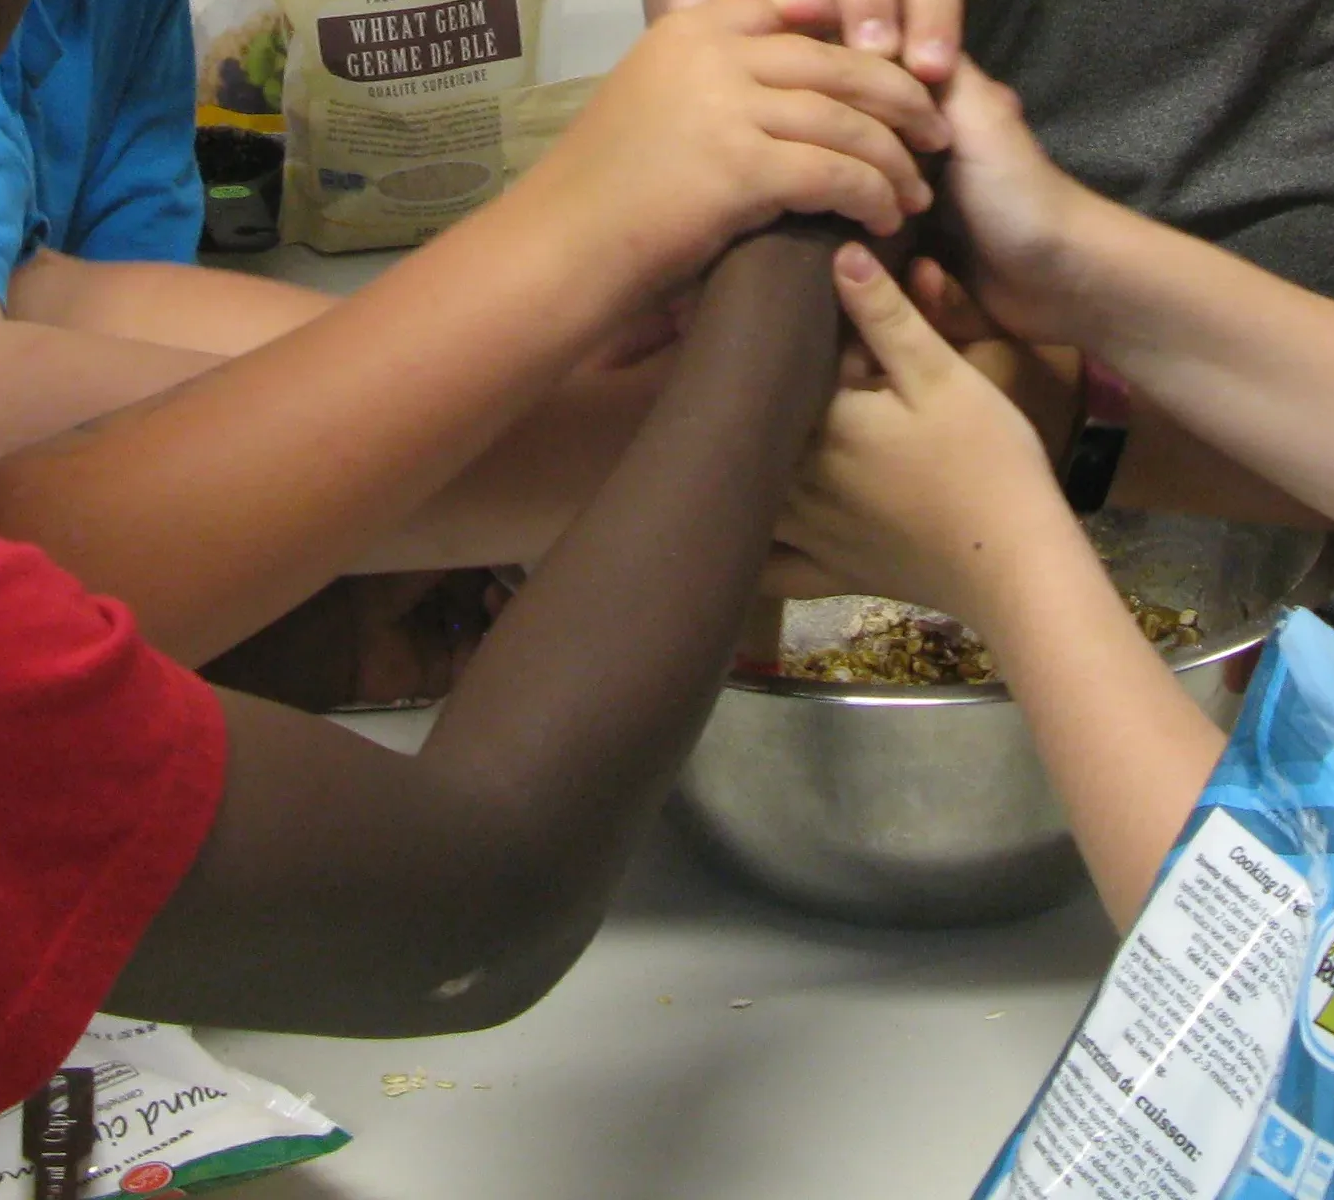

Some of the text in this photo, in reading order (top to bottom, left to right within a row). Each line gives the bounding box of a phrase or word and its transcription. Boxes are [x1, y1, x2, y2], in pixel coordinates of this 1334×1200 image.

[349, 0, 486, 45] WHEAT GERM
[346, 28, 499, 78] GERME DE BLÉ
[1228, 845, 1278, 894] Cooking
[1134, 1094, 1204, 1163] cuisson:
